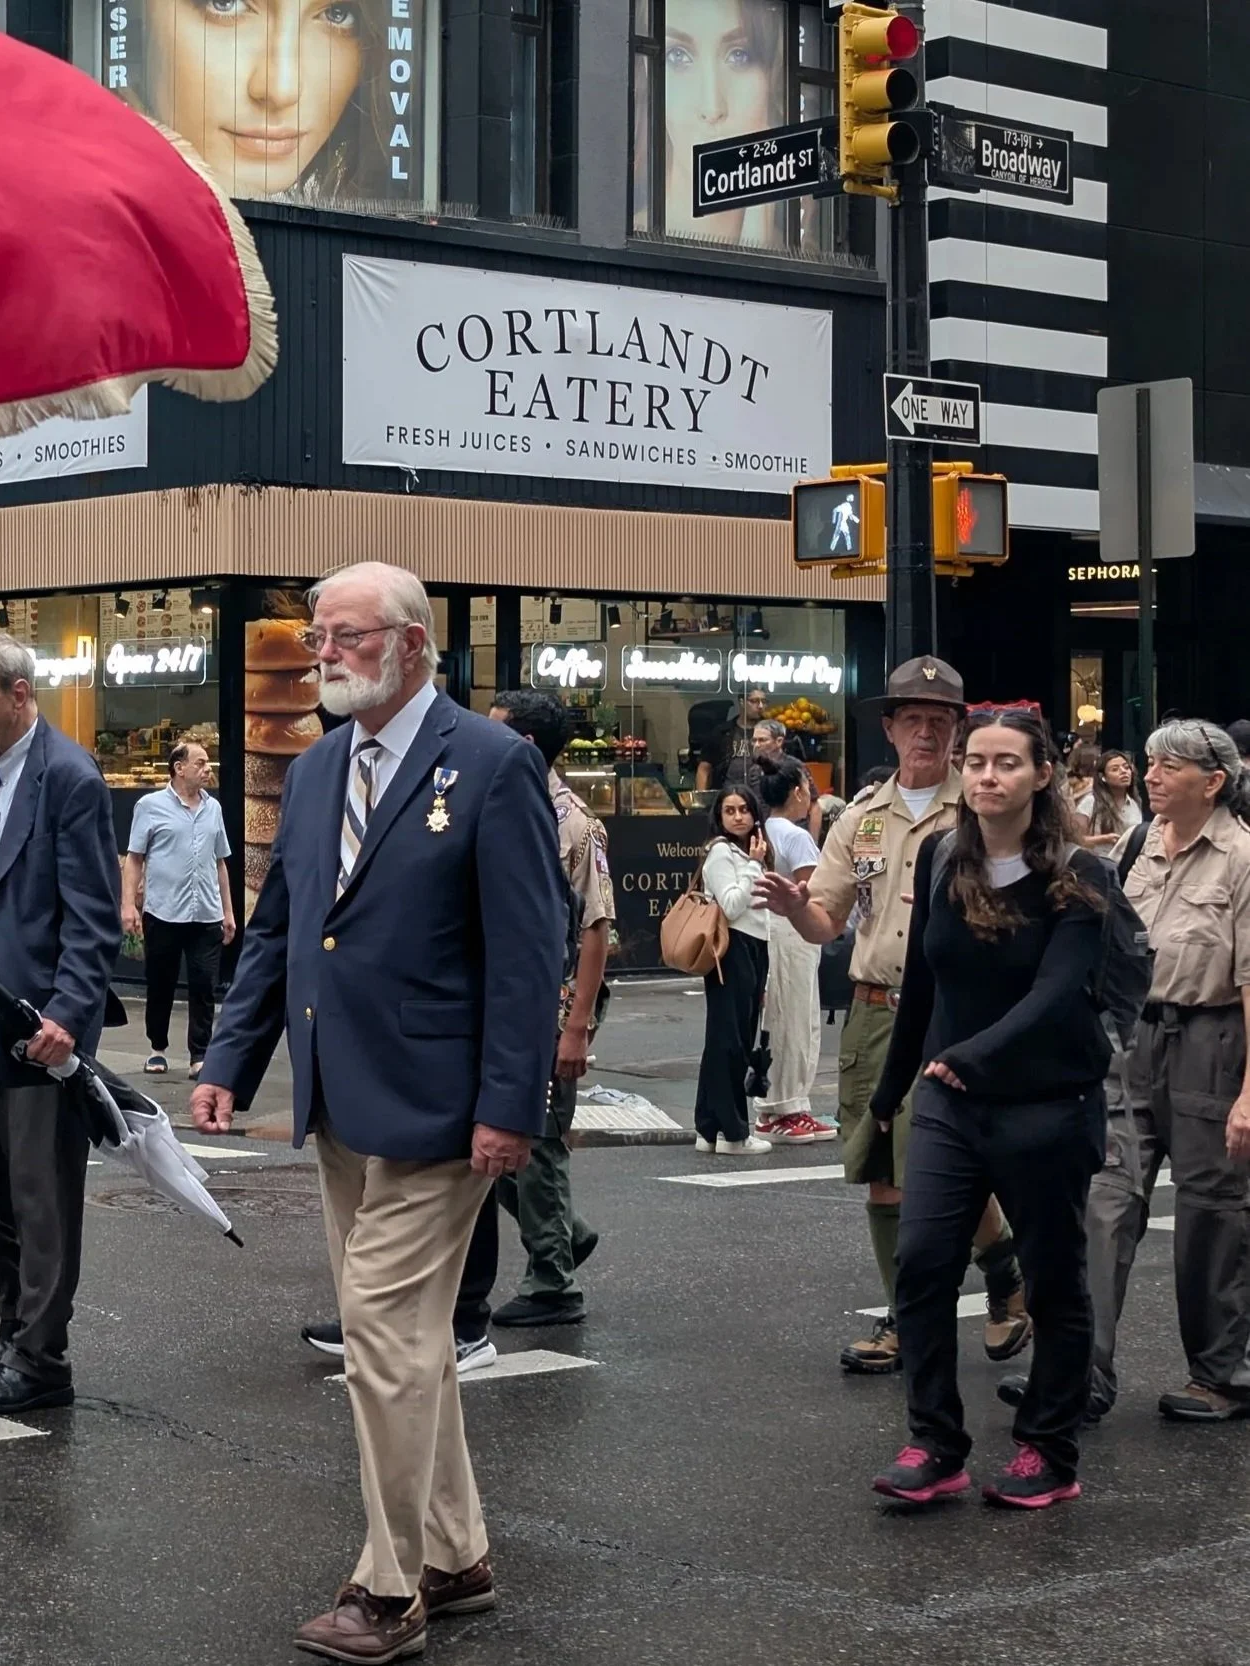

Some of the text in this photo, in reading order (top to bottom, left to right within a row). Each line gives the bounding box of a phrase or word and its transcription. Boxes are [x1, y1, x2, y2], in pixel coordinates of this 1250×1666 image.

[108, 0, 128, 89] SER
[753, 140, 778, 159] 2-26
[1003, 130, 1032, 149] 173-191
[704, 148, 814, 197] Cortlandt ST
[981, 139, 1062, 187] Broadway
[990, 169, 1053, 189] CANYON OF HEROES
[415, 308, 770, 405] CORTLANDT
[484, 369, 712, 433] EATERY
[900, 396, 969, 426] ONE WAY
[34, 435, 126, 463] SMOOTHIES
[385, 424, 808, 475] FRESH JUICES SANDWICHES SMOOTHIE
[1067, 564, 1141, 581] SEPHORA
[106, 643, 203, 685] Open 24/7
[536, 646, 603, 688] Coffee
